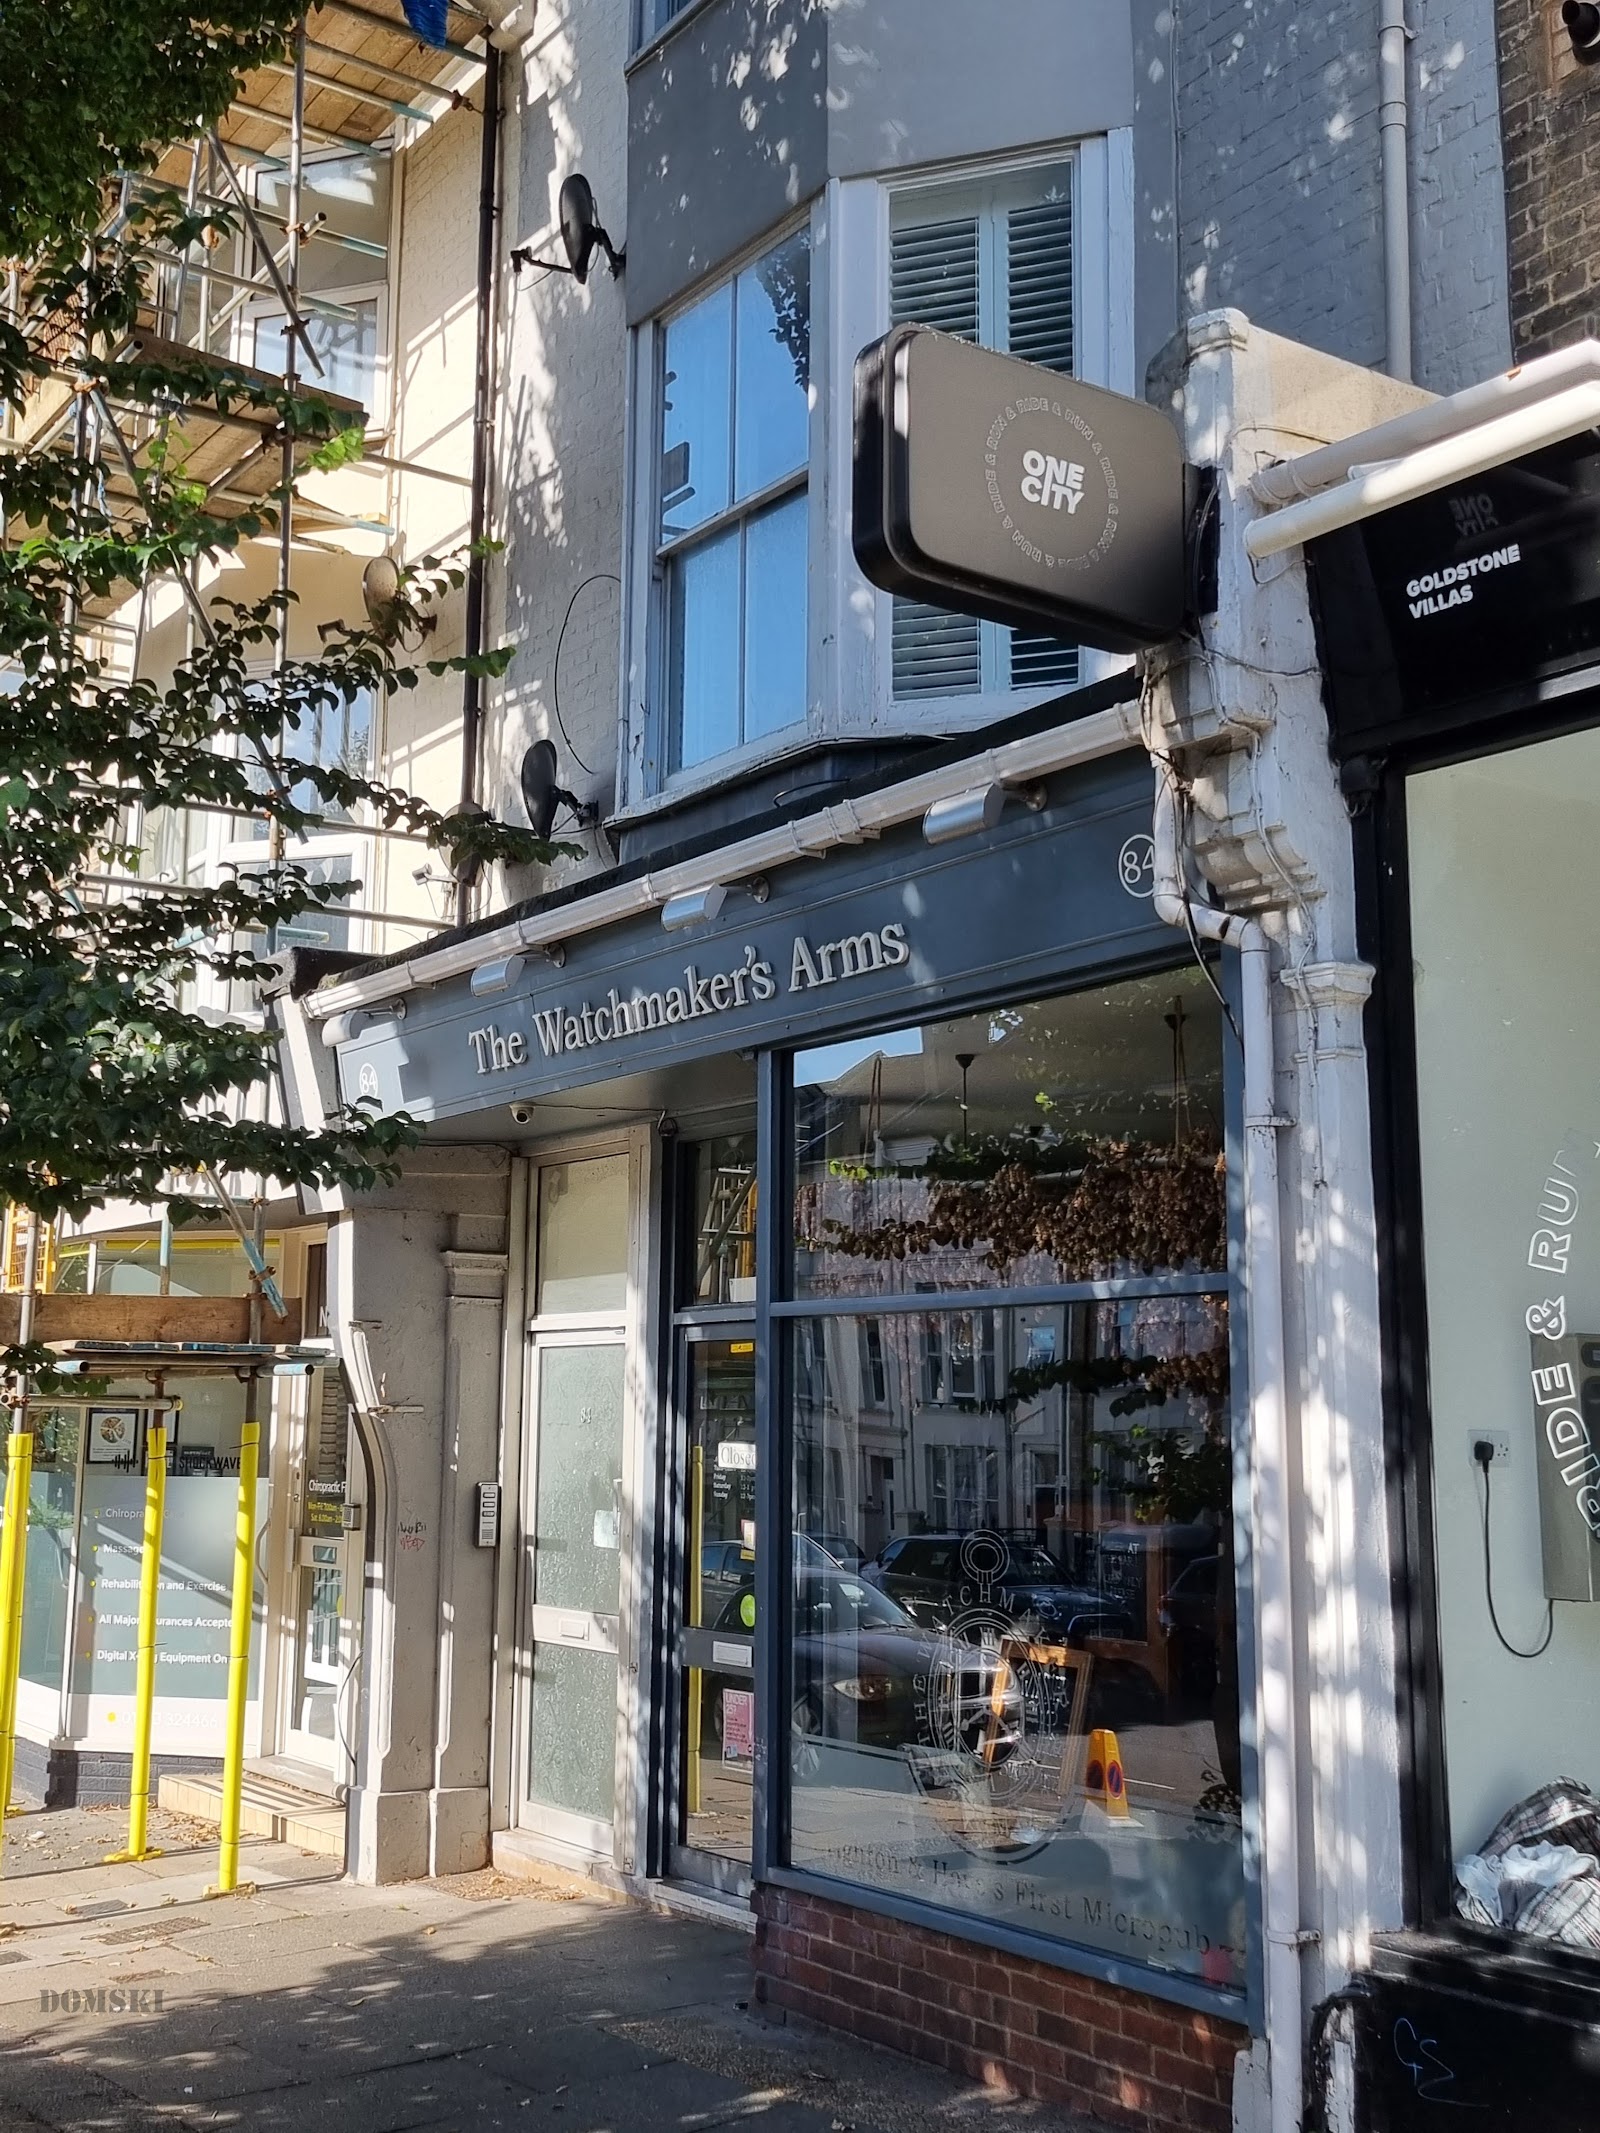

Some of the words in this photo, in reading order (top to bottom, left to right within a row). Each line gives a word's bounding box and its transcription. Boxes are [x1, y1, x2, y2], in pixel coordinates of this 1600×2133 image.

[1016, 397, 1048, 413] RIDE
[1065, 409, 1094, 441] RUN
[1022, 450, 1085, 490] ONE
[1100, 457, 1118, 499] RIDE
[985, 469, 1005, 513] RIDE
[1021, 475, 1085, 515] CITY
[1012, 530, 1042, 563] RUN
[1406, 543, 1521, 598] GOLDSTONE
[1408, 584, 1474, 619] VILLAS
[1123, 845, 1153, 884] 84
[468, 1023, 527, 1075] The
[531, 945, 776, 1058] Watchmaker's
[787, 923, 910, 993] Arms
[362, 1070, 377, 1093] 84
[1526, 1296, 1565, 1340] &
[105, 1508, 146, 1520] Chiropra
[166, 1581, 185, 1591] and
[186, 1581, 227, 1592] Exercise
[98, 1614, 112, 1625] All
[113, 1615, 140, 1627] Major
[155, 1617, 193, 1627] urances
[194, 1617, 232, 1630] Accepte
[97, 1650, 128, 1662] Digital
[159, 1652, 211, 1666] Equipment
[1016, 1880, 1071, 1921] First
[1083, 1896, 1211, 1955] Micropub
